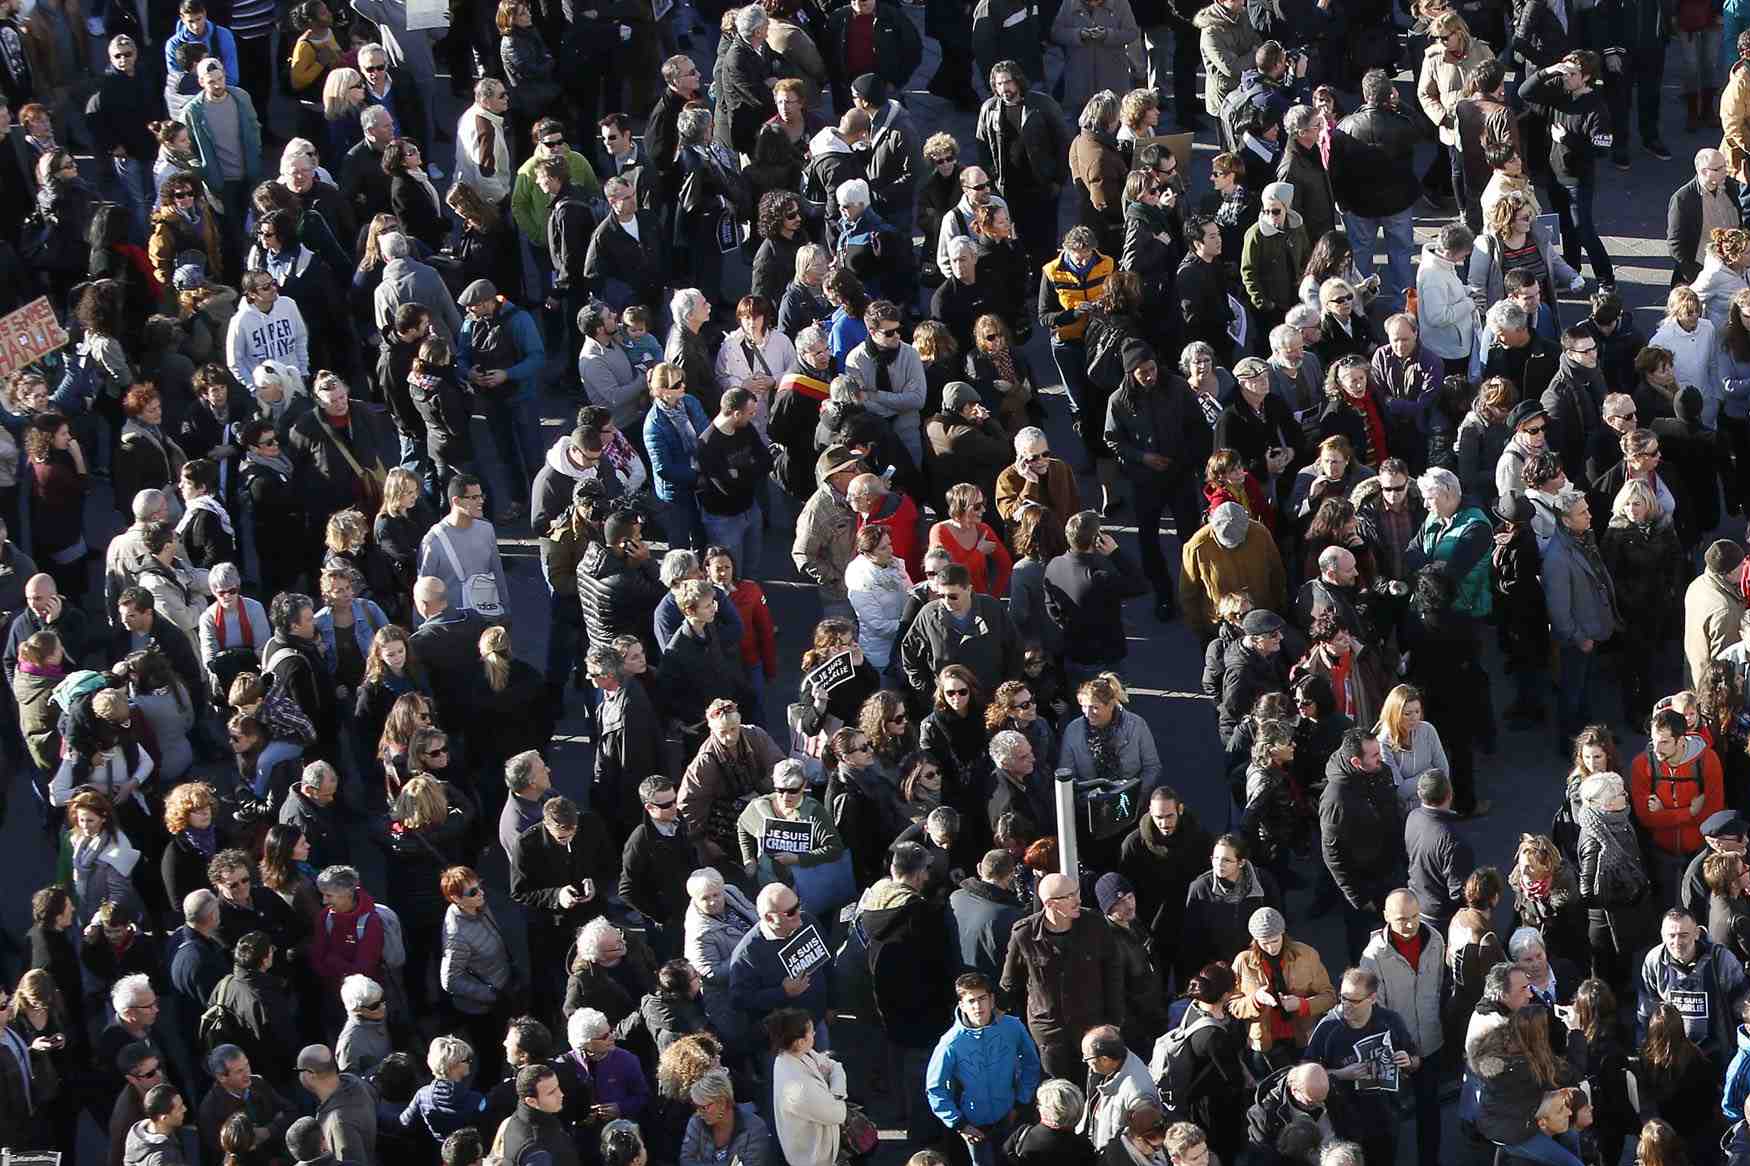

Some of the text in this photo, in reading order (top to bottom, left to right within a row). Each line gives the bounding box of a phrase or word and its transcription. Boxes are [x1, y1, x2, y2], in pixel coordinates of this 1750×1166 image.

[818, 658, 843, 682] JE SUIS
[766, 830, 809, 841] JE SUIS
[766, 838, 809, 852] CHARLIE
[788, 937, 819, 967] JE SUIS
[791, 945, 825, 977] CHARLIE
